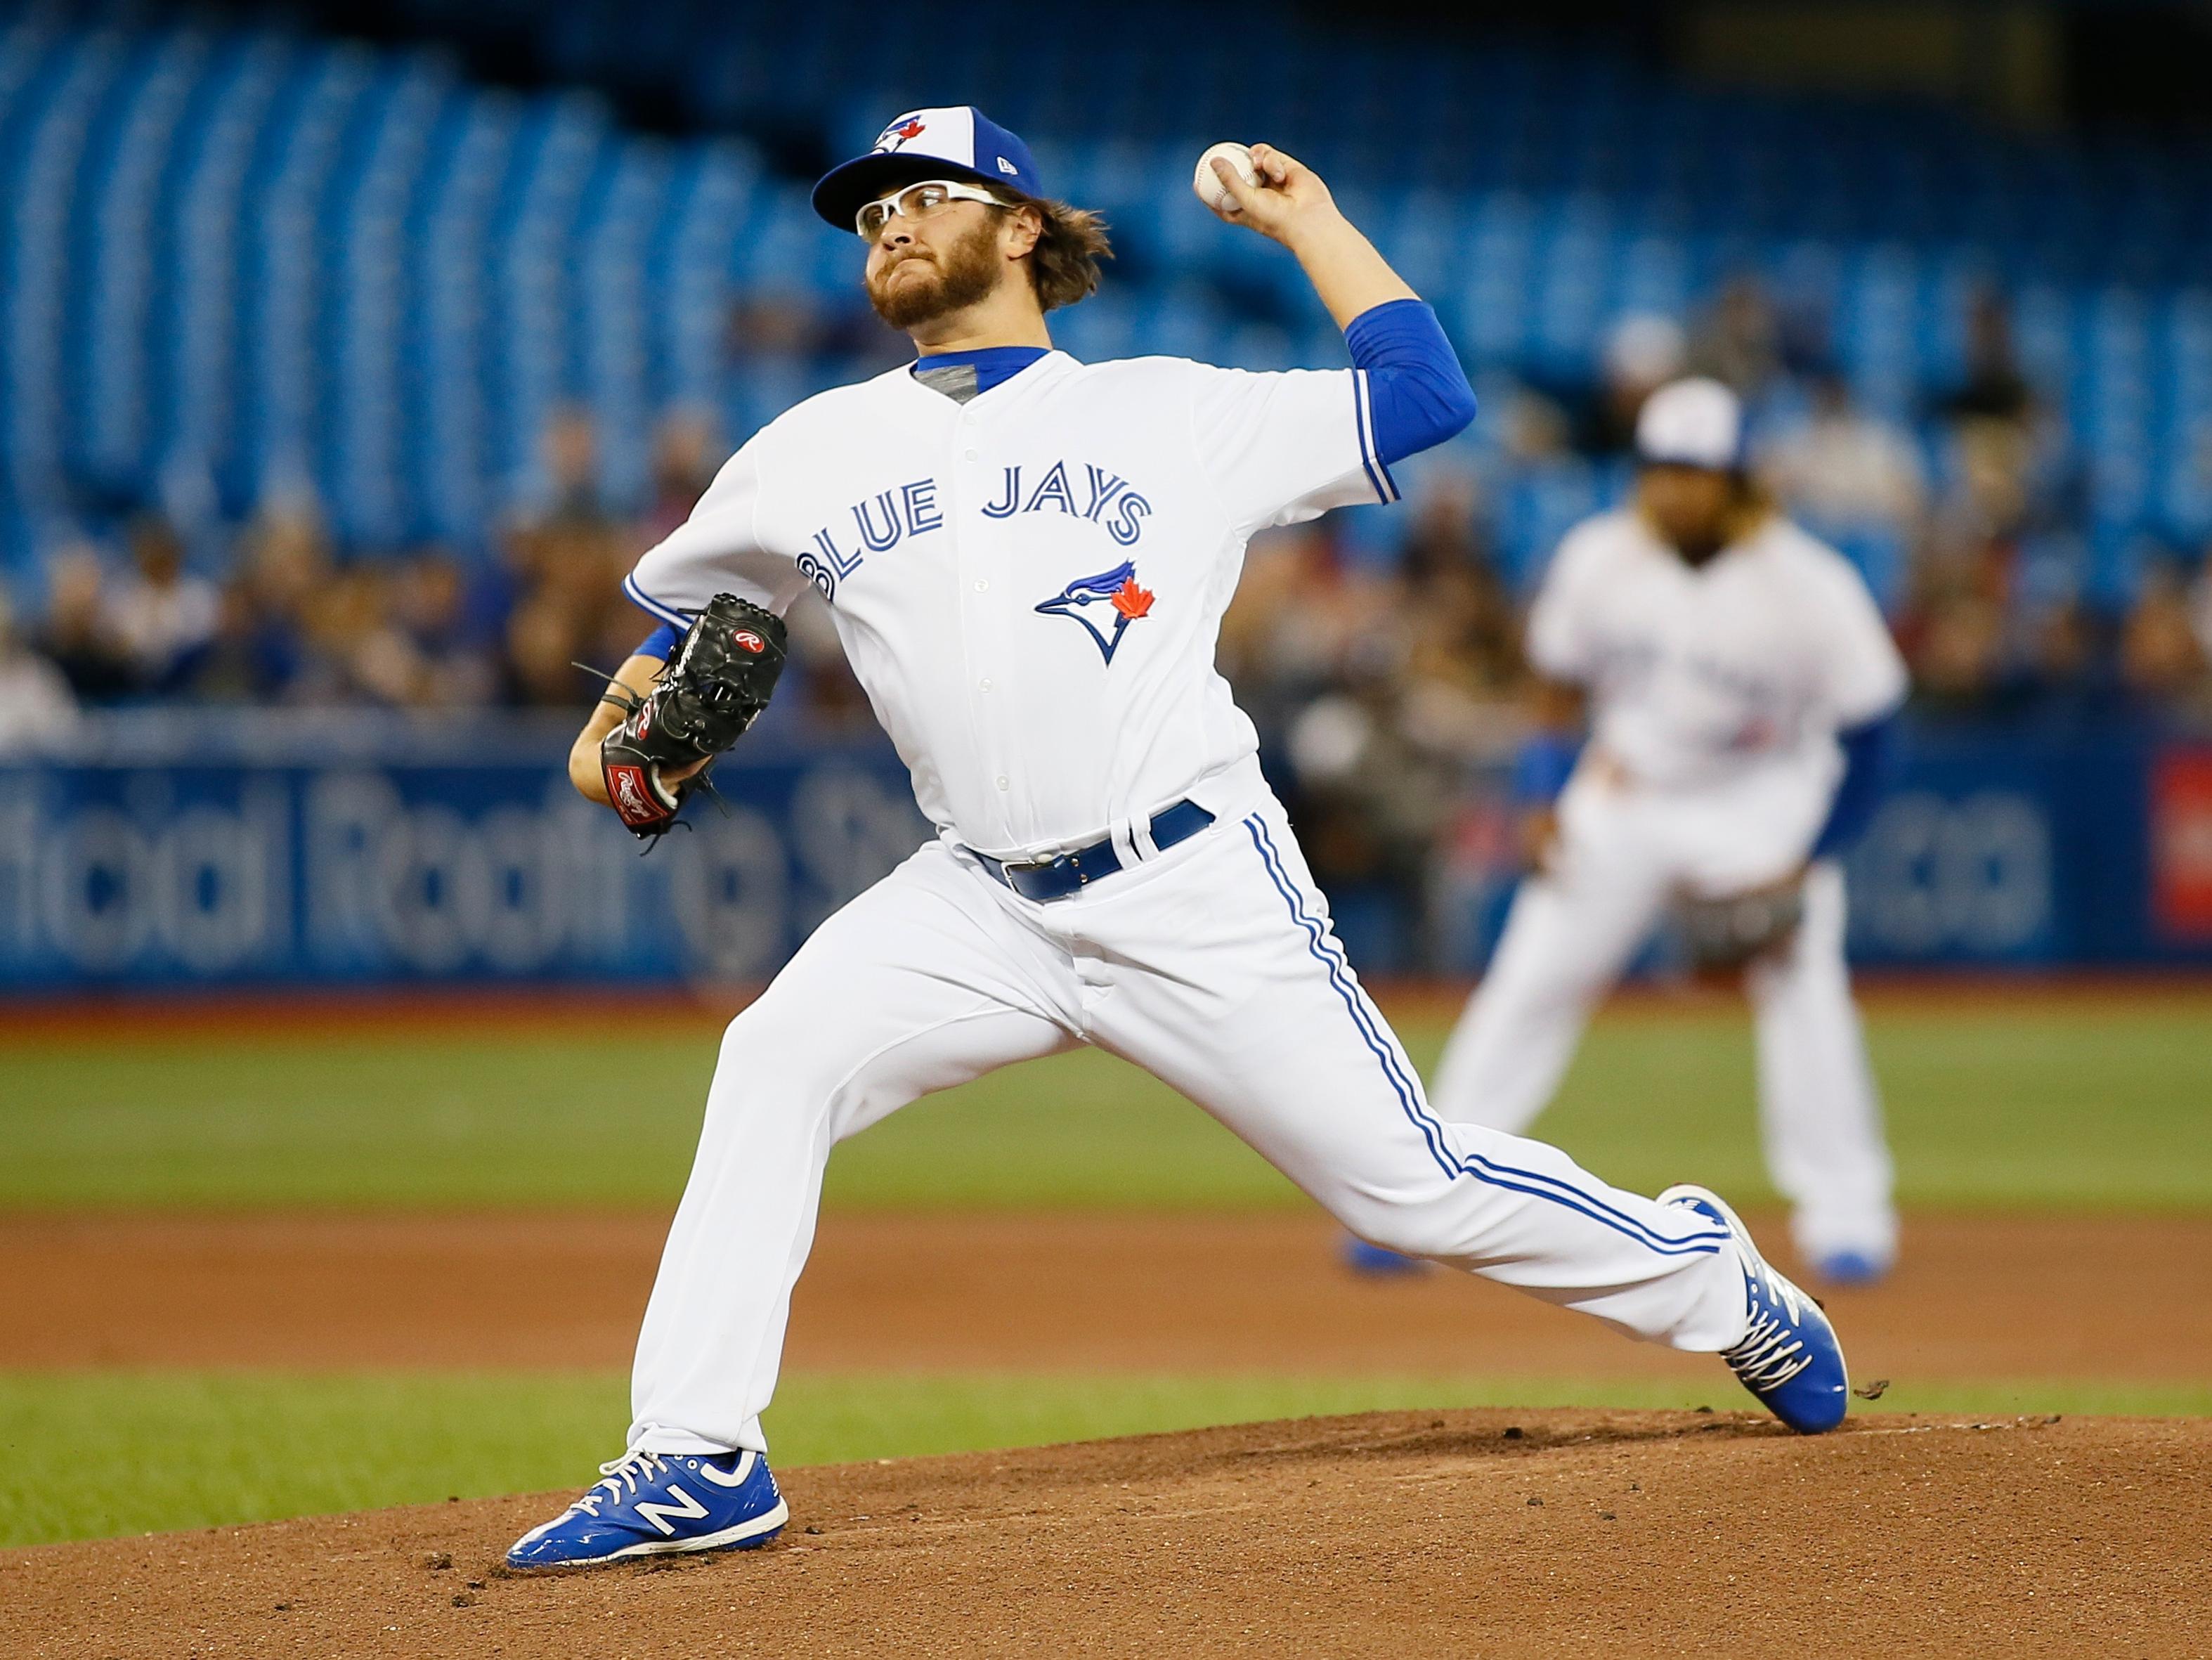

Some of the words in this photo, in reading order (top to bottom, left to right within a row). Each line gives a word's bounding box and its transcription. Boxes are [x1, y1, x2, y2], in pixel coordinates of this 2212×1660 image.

[796, 478, 943, 602] BLUE
[982, 460, 1154, 546] JAYS
[634, 1484, 710, 1536] N
